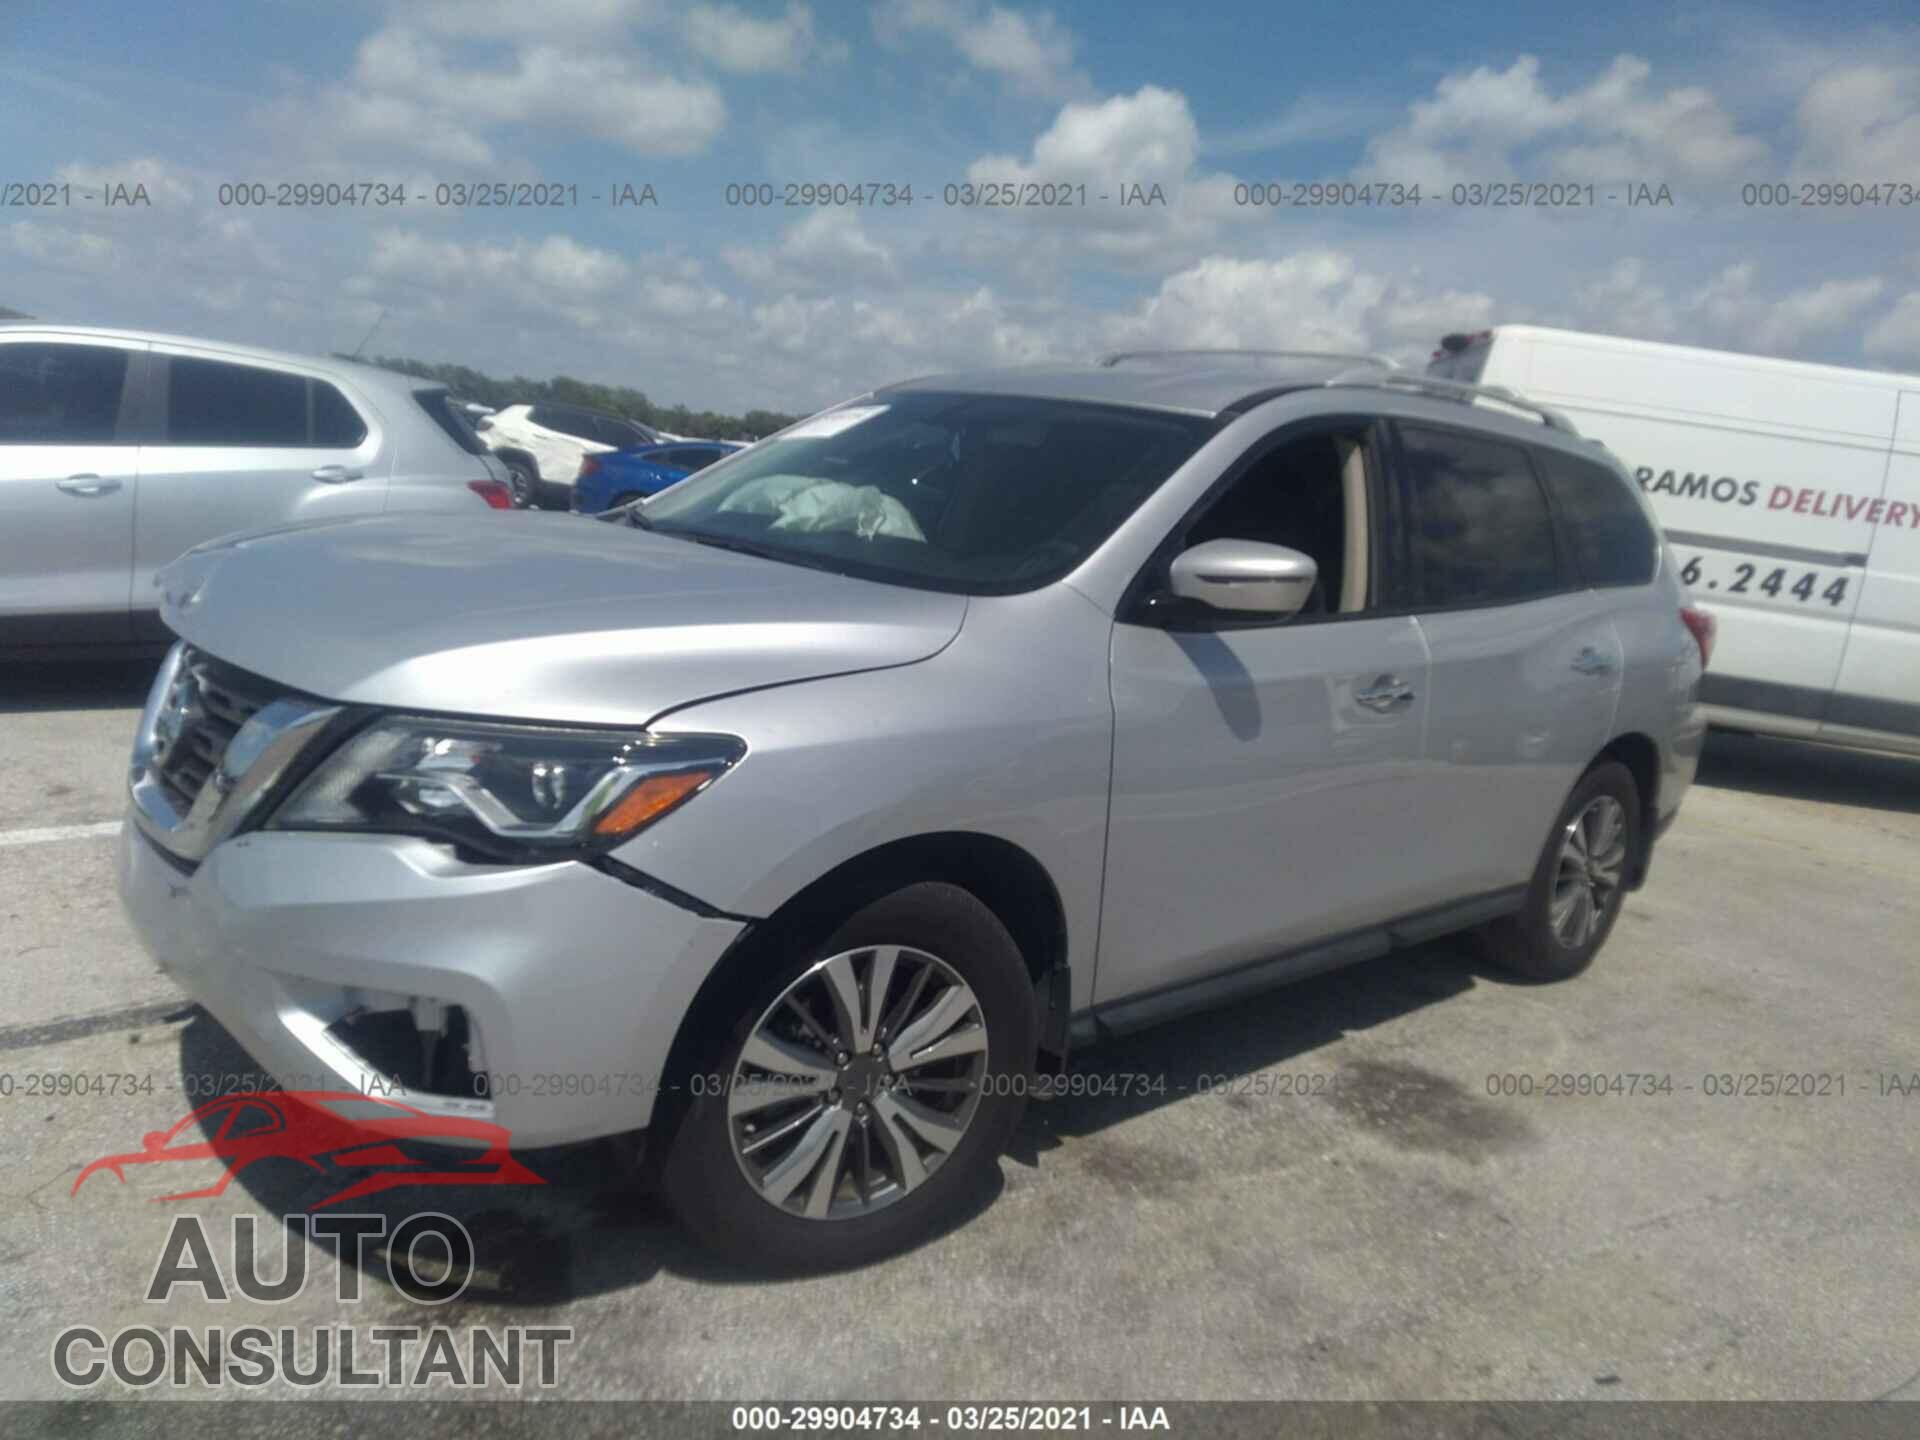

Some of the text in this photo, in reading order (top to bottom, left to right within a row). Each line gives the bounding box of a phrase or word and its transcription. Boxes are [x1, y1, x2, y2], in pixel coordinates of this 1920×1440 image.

[1635, 466, 1920, 529] RAMOS DELIVERY
[1680, 556, 1850, 607] 6.2444
